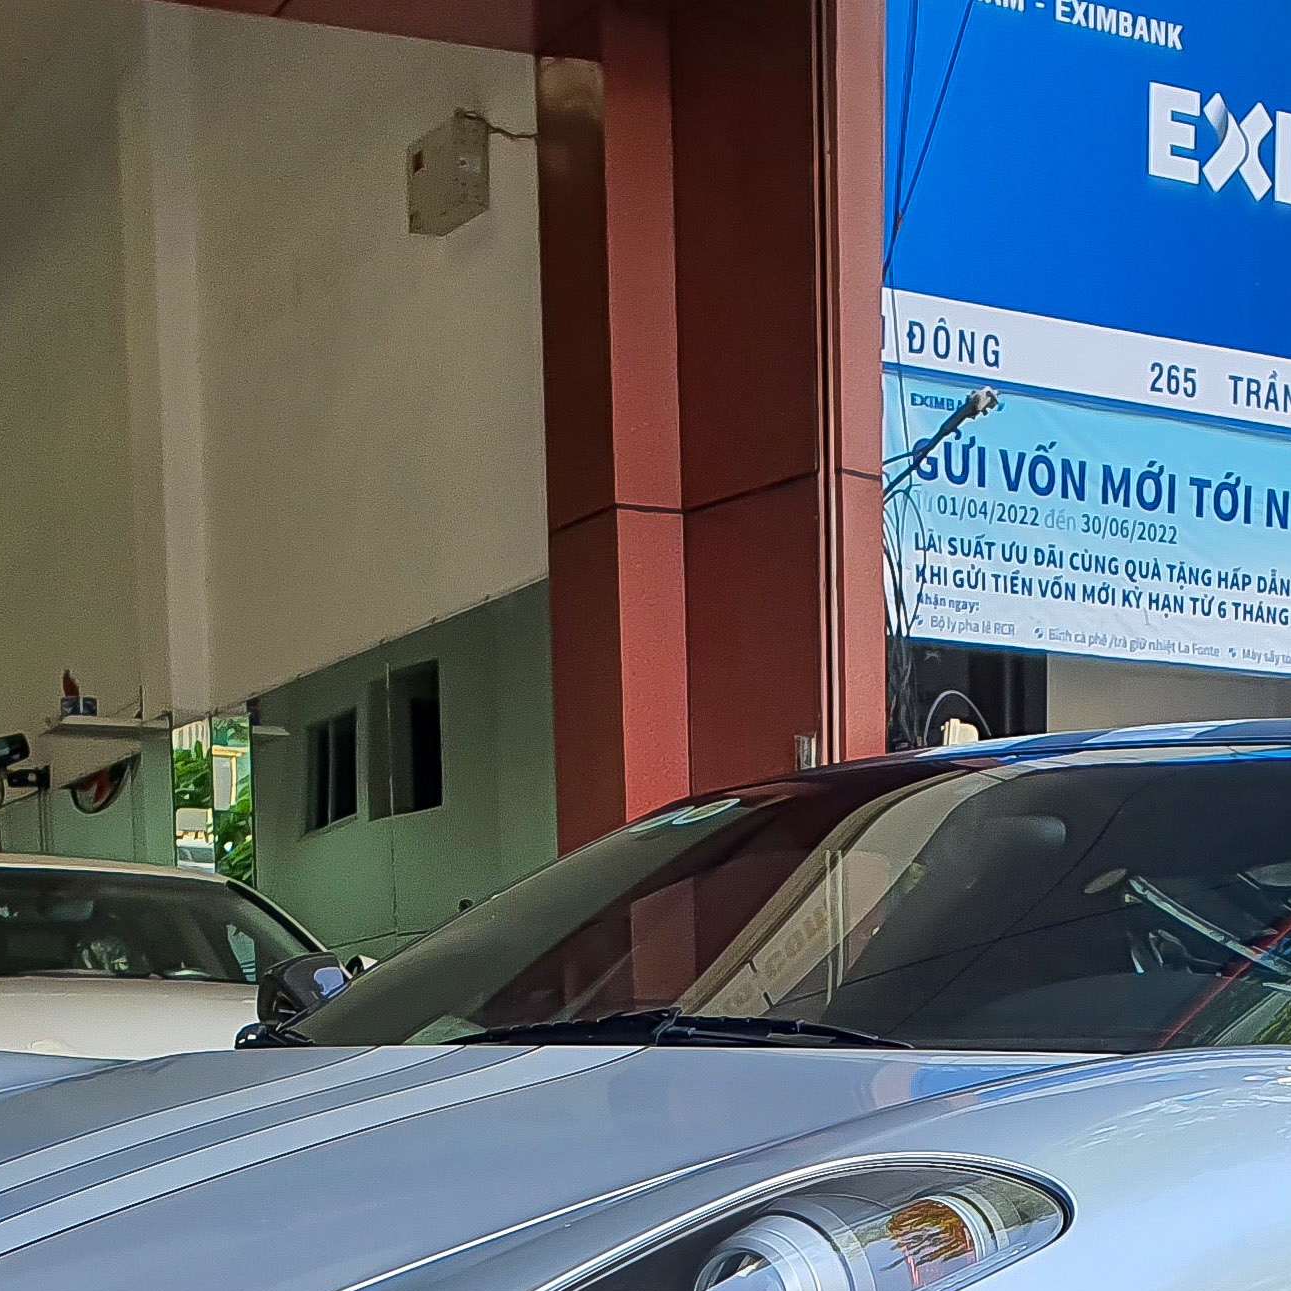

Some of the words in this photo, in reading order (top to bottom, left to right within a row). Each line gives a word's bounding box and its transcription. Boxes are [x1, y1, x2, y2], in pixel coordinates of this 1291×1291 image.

[1055, 0, 1183, 50] EXIMBANK
[906, 317, 1000, 369] ĐÔNG
[1149, 362, 1198, 398] 265
[912, 430, 986, 489] GỬI
[998, 441, 1087, 502] VỐN
[1101, 460, 1176, 514] MỚI
[1189, 471, 1253, 524] TỚI
[937, 494, 1040, 527] 01/04/2022
[1044, 507, 1077, 531] đến
[1080, 513, 1177, 545] 30/06/2022
[914, 528, 943, 555] LÃI
[948, 534, 996, 561] SUẤT
[1001, 540, 1028, 564] ƯU
[1034, 544, 1064, 569] ĐÃI
[1069, 549, 1120, 575] CÙNG
[1124, 558, 1161, 582] QUÀ
[1166, 561, 1212, 591] TẶNG
[1217, 567, 1252, 592] HẤP
[1257, 569, 1291, 597] DẪN
[915, 564, 948, 586] KHI
[952, 564, 986, 591] GỬI
[1038, 574, 1076, 602] VỐN
[1082, 582, 1117, 607] MỚI
[1149, 592, 1184, 618] HẠN
[1189, 594, 1215, 617] TỪ
[1218, 601, 1227, 618] 6
[1232, 601, 1289, 626] THÁNG
